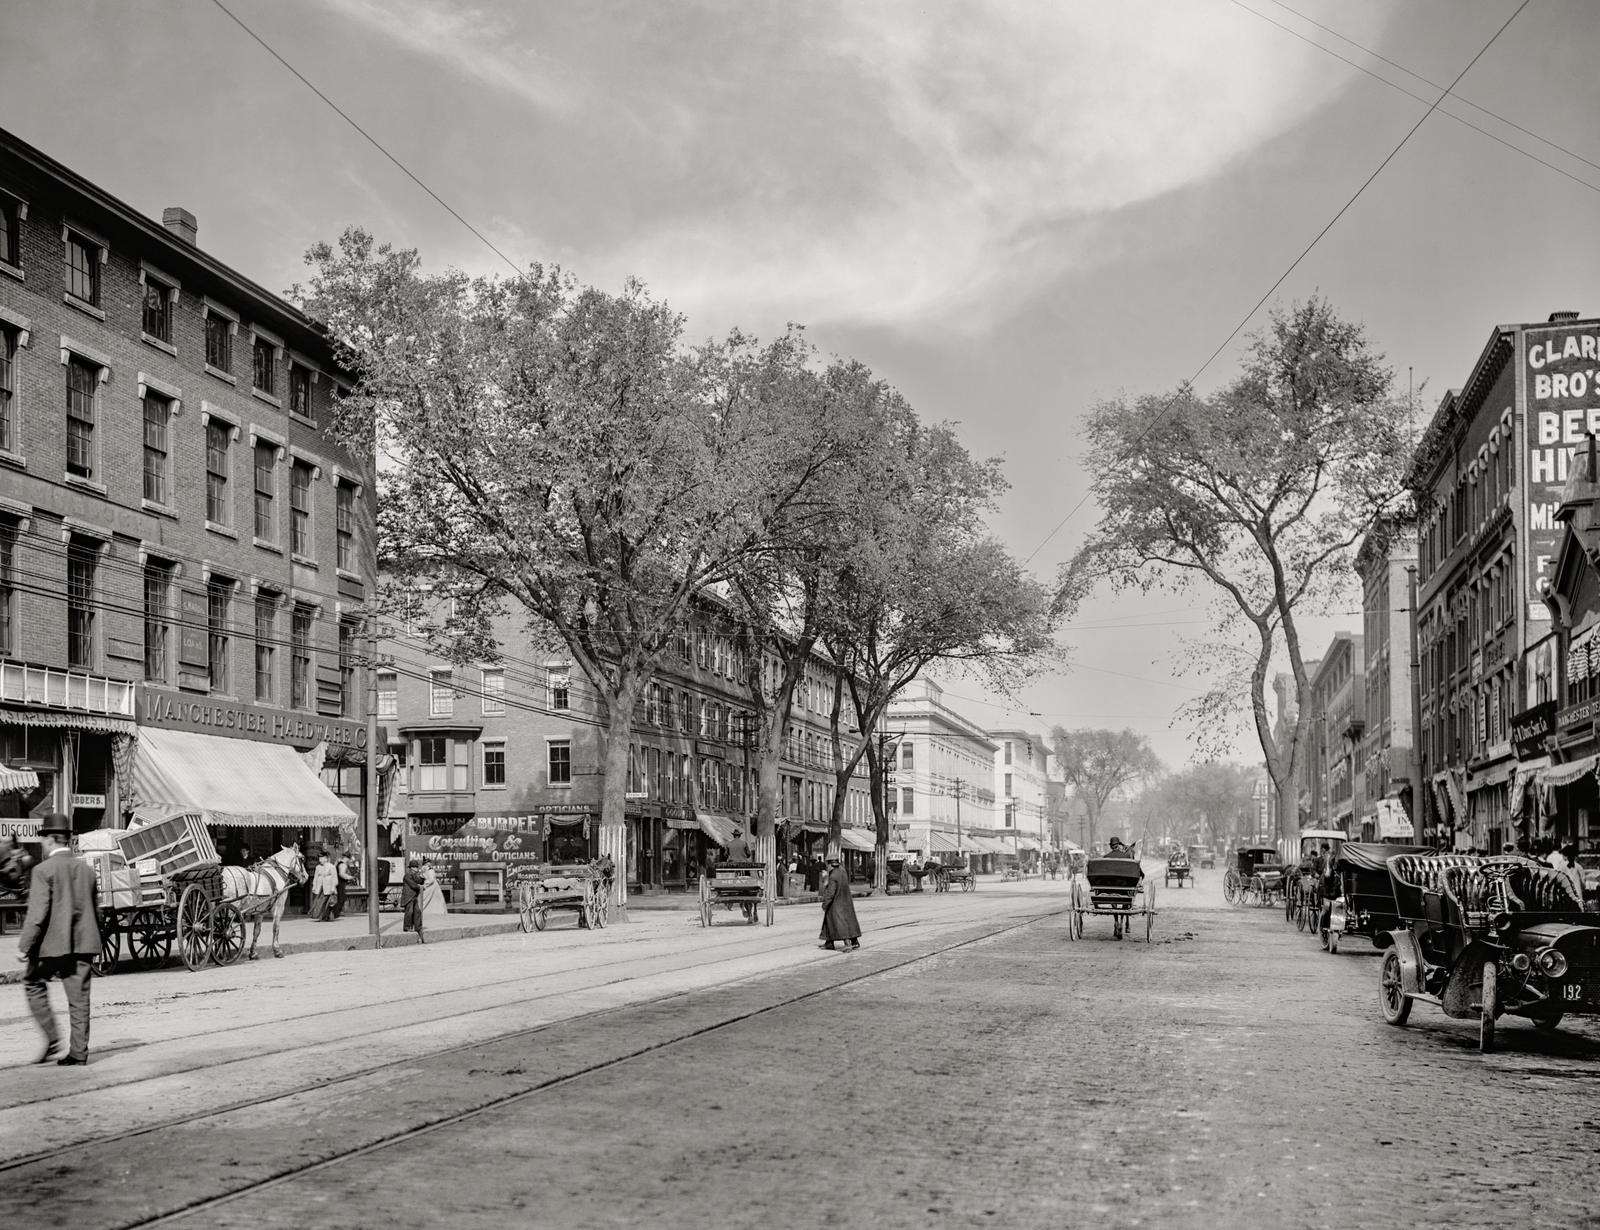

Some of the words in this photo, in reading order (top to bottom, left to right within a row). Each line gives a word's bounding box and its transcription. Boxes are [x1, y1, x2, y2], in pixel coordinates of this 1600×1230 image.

[1529, 335, 1600, 369] CLAR
[146, 693, 267, 733] MANCHESTER
[272, 713, 350, 745] HARDWARE
[354, 726, 367, 748] C
[539, 805, 593, 813] OPTICIANS.
[665, 808, 694, 818] GOODIN
[408, 816, 466, 836] BROWN
[467, 820, 477, 828] &
[477, 815, 540, 835] BURPEE
[428, 835, 498, 854] Consulting
[503, 834, 523, 850] &
[409, 851, 479, 861] MANUFACTURING
[491, 850, 539, 861] OPTICIANS.
[1563, 984, 1582, 999] 192
